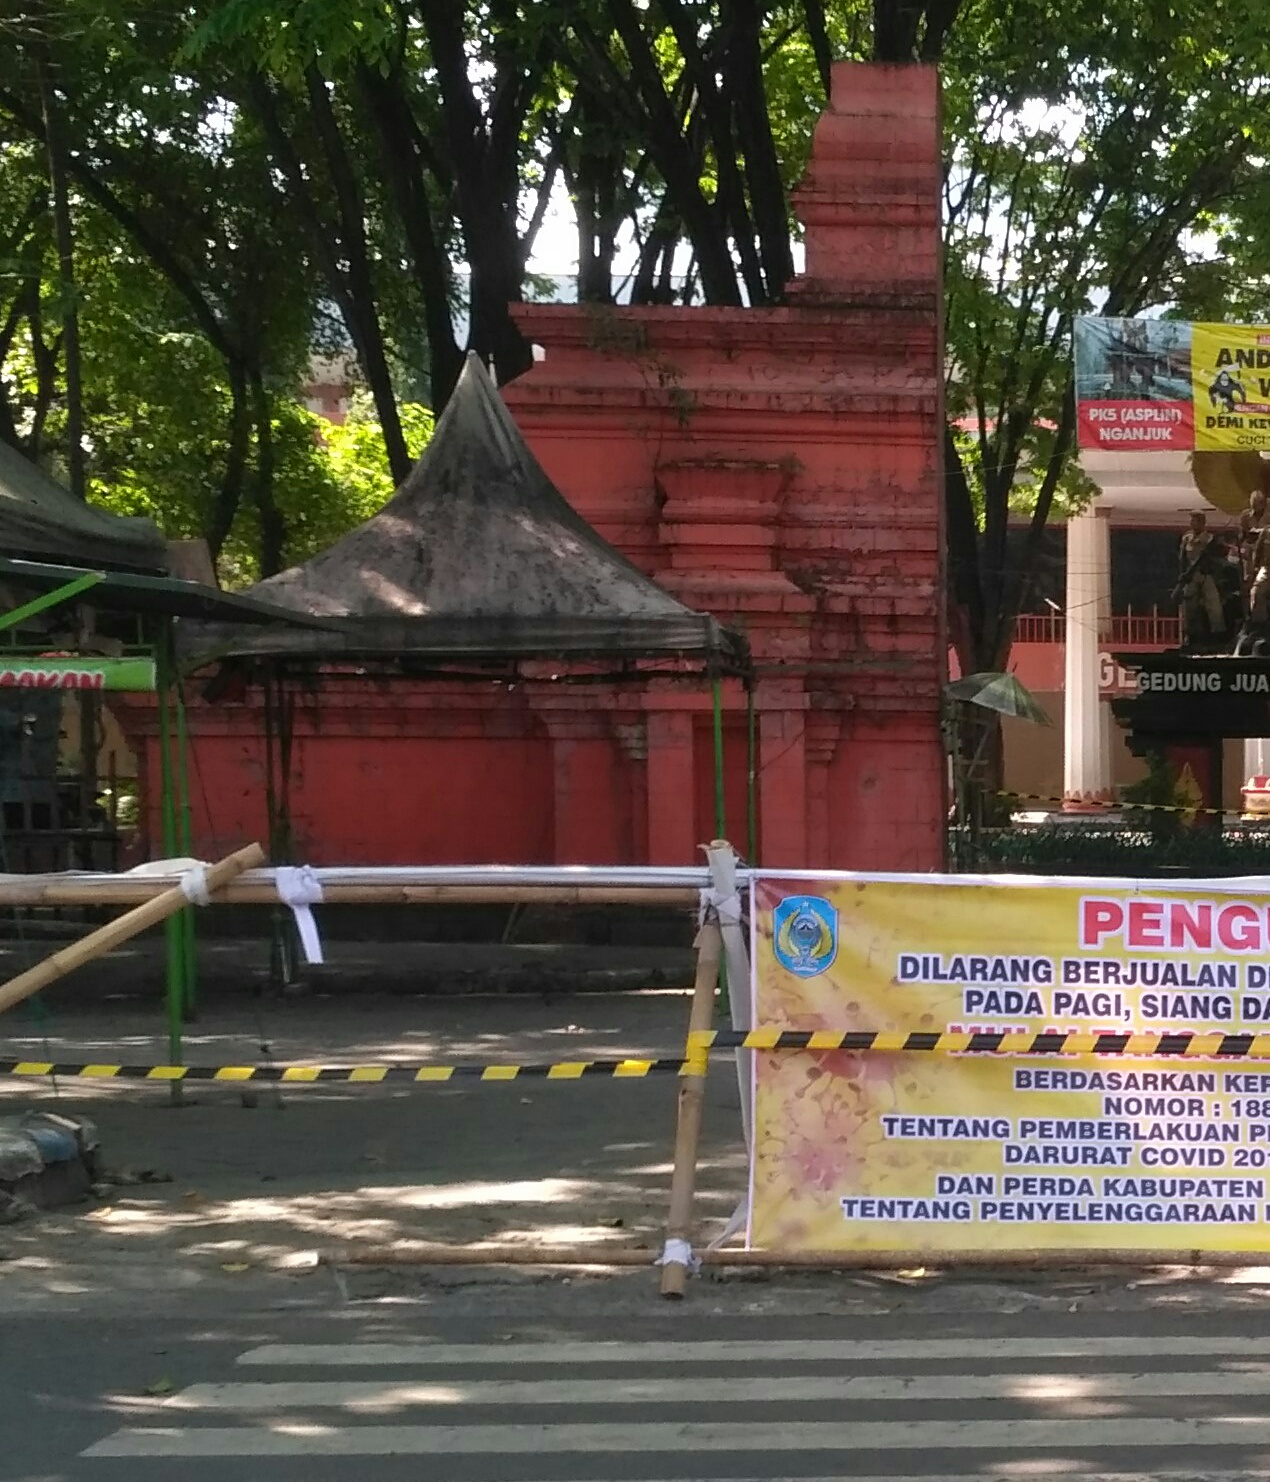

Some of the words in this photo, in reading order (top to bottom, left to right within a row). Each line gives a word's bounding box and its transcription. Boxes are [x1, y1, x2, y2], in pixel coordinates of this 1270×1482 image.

[1089, 408, 1116, 421] PK5
[1206, 416, 1244, 429] DEMI
[1099, 427, 1174, 441] NGANJUK
[1236, 434, 1265, 445] CUCI
[1137, 672, 1221, 691] GEDUNG
[901, 957, 1051, 982] DILARANG
[1064, 961, 1235, 987] BERJUALAN
[966, 991, 1042, 1014] PADA
[1055, 993, 1131, 1022] PAGI,
[1143, 995, 1231, 1019] SIANG
[1016, 1071, 1214, 1090] BERDASARKAN
[1105, 1098, 1203, 1116] NOMOR
[883, 1118, 1009, 1137] TENTANG
[1021, 1121, 1238, 1141] PEMBERLAKUAN
[1006, 1145, 1131, 1164] DARURAT
[1142, 1148, 1224, 1165] COVID
[939, 1177, 993, 1194] DAN
[1005, 1178, 1093, 1195] PERDA
[1104, 1179, 1262, 1197] KABUPATEN
[843, 1200, 969, 1219] TENTANG
[982, 1202, 1254, 1221] PENYELENGGARAAN
